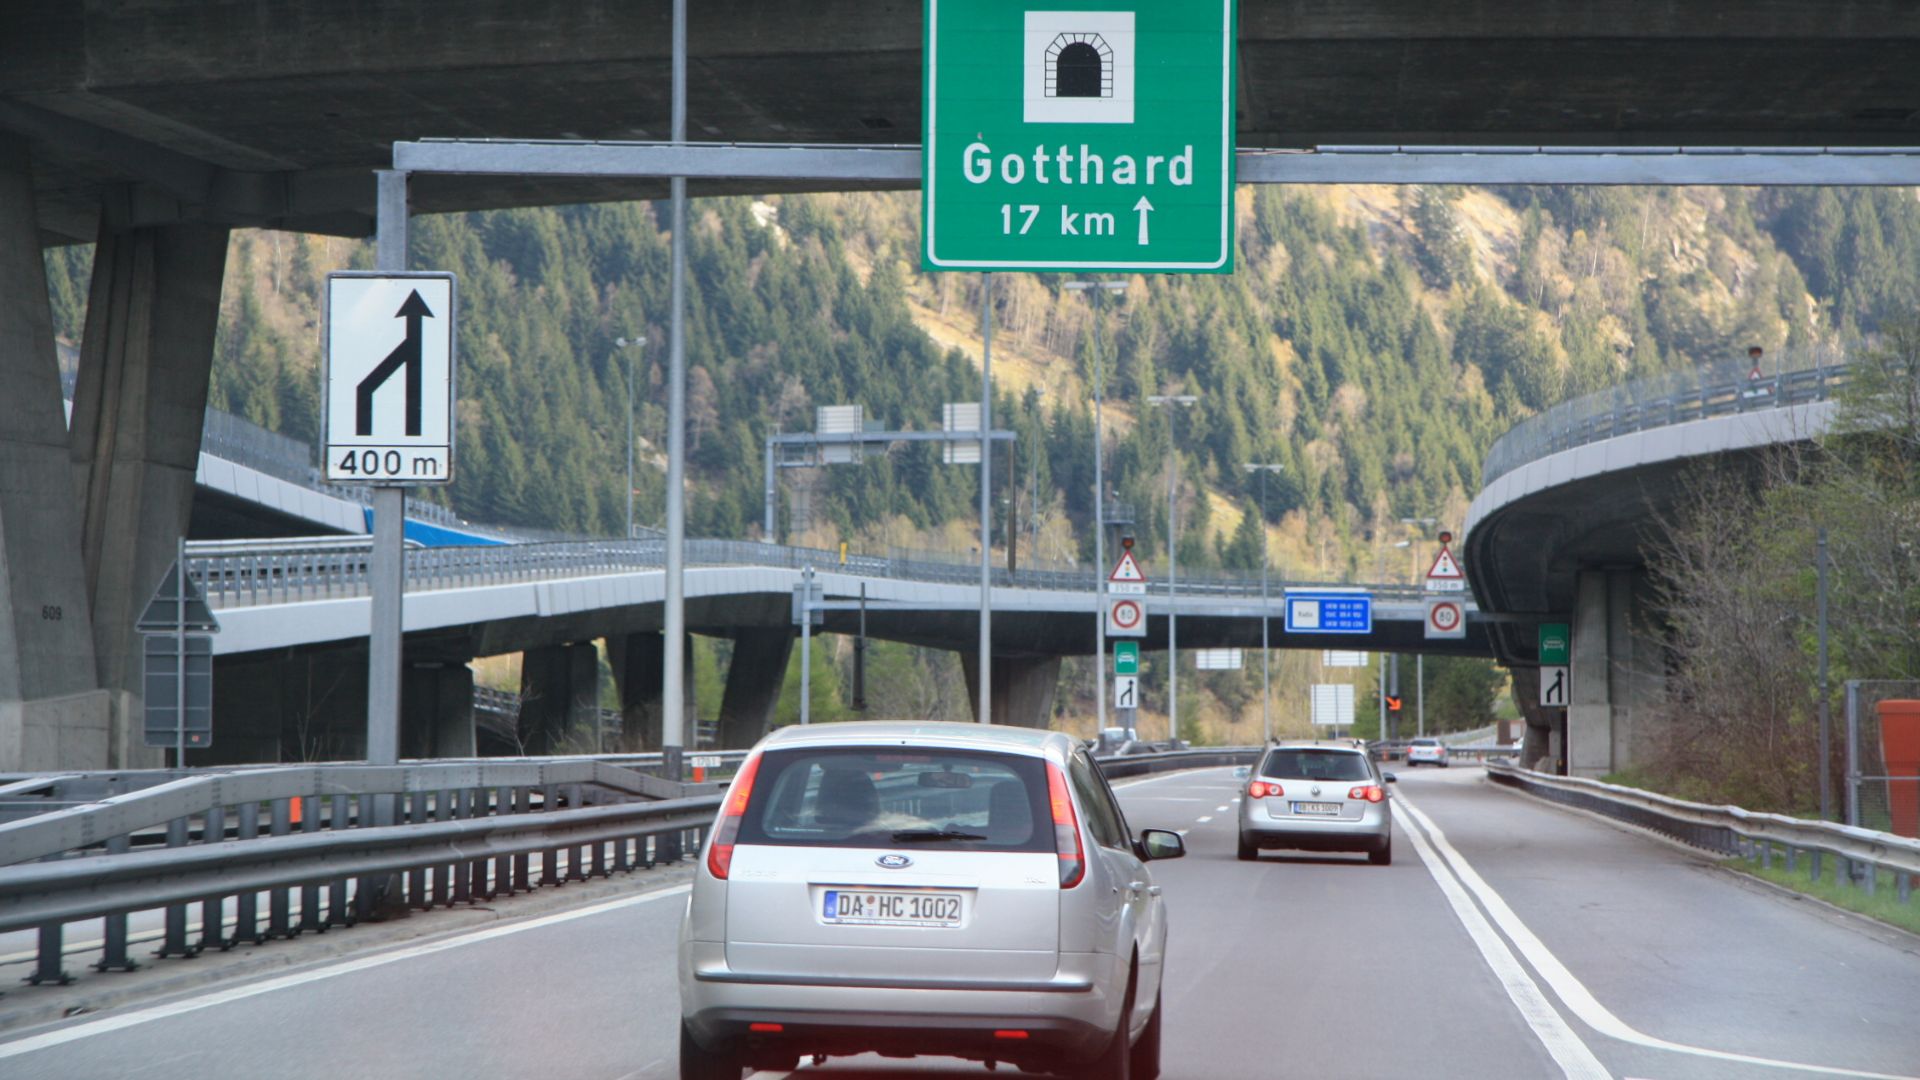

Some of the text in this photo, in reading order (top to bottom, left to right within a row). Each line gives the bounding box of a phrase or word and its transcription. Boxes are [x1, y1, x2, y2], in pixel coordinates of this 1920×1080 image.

[963, 142, 1193, 186] Gotthard
[1001, 204, 1115, 235] 17 km
[339, 450, 437, 475] 400 m
[42, 605, 62, 620] 609
[1120, 609, 1133, 620] 80
[1440, 611, 1452, 622] 80
[838, 894, 960, 920] DA HC 1002
